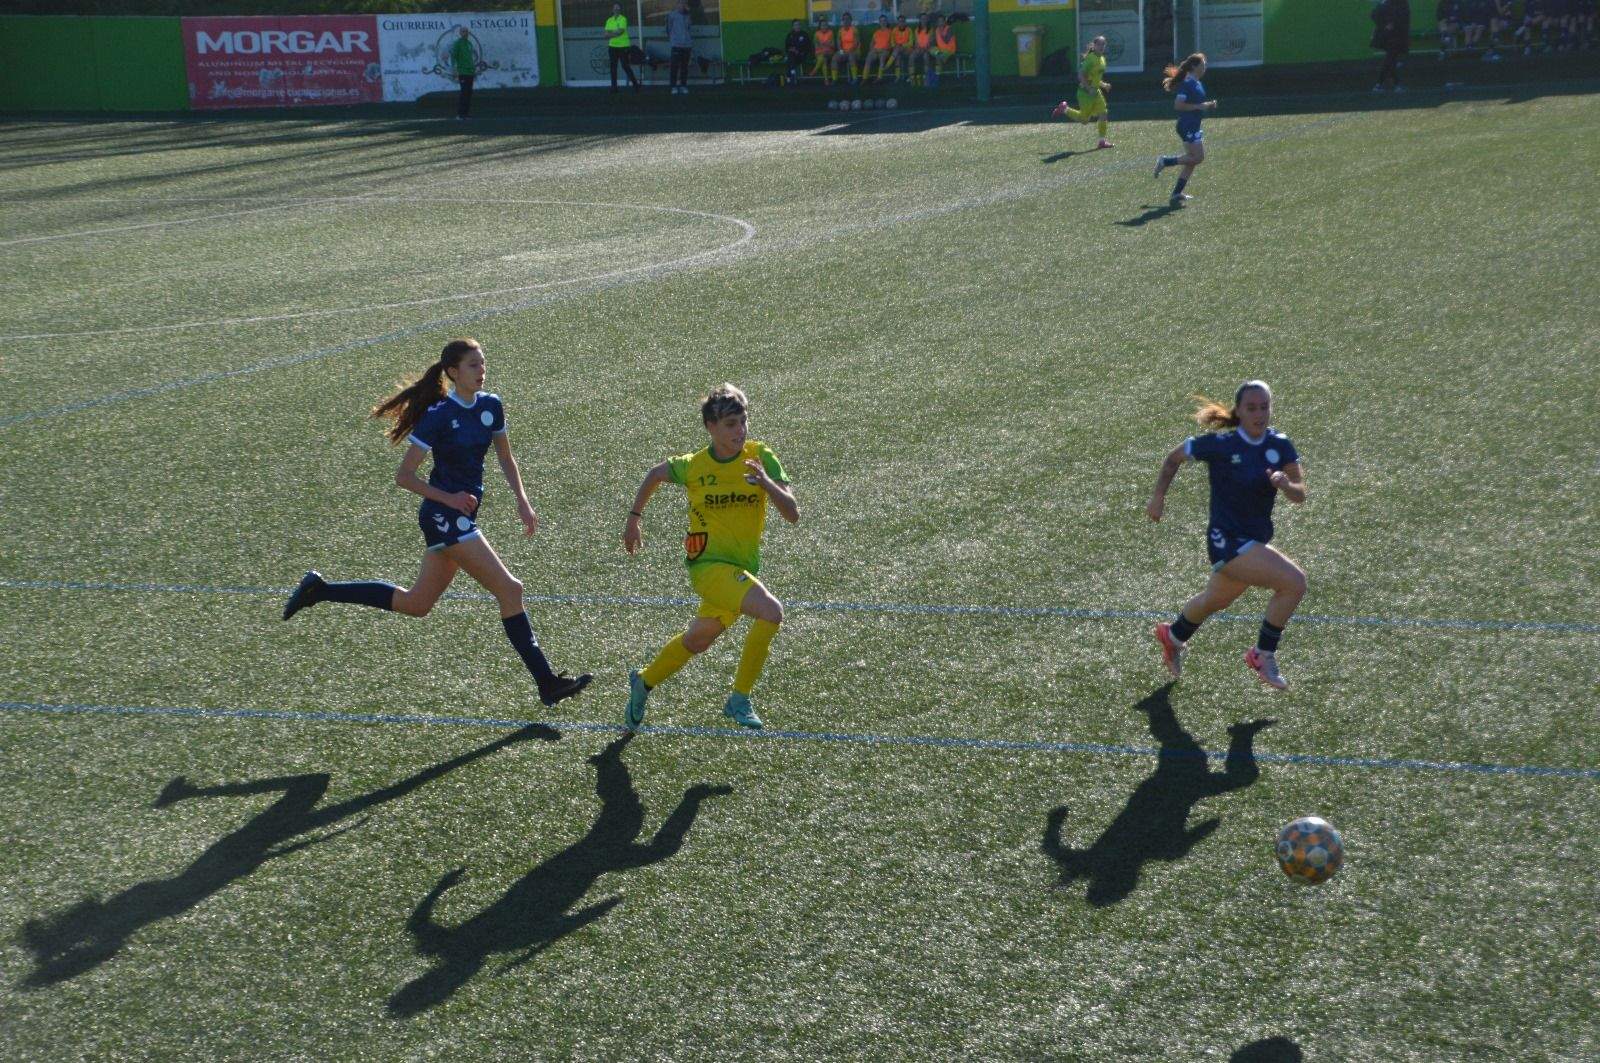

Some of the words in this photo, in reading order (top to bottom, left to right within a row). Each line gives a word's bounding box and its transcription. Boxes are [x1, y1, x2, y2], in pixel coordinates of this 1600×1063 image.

[382, 19, 446, 31] CHURRERIA
[196, 30, 372, 54] MORGAR
[697, 474, 718, 486] 12
